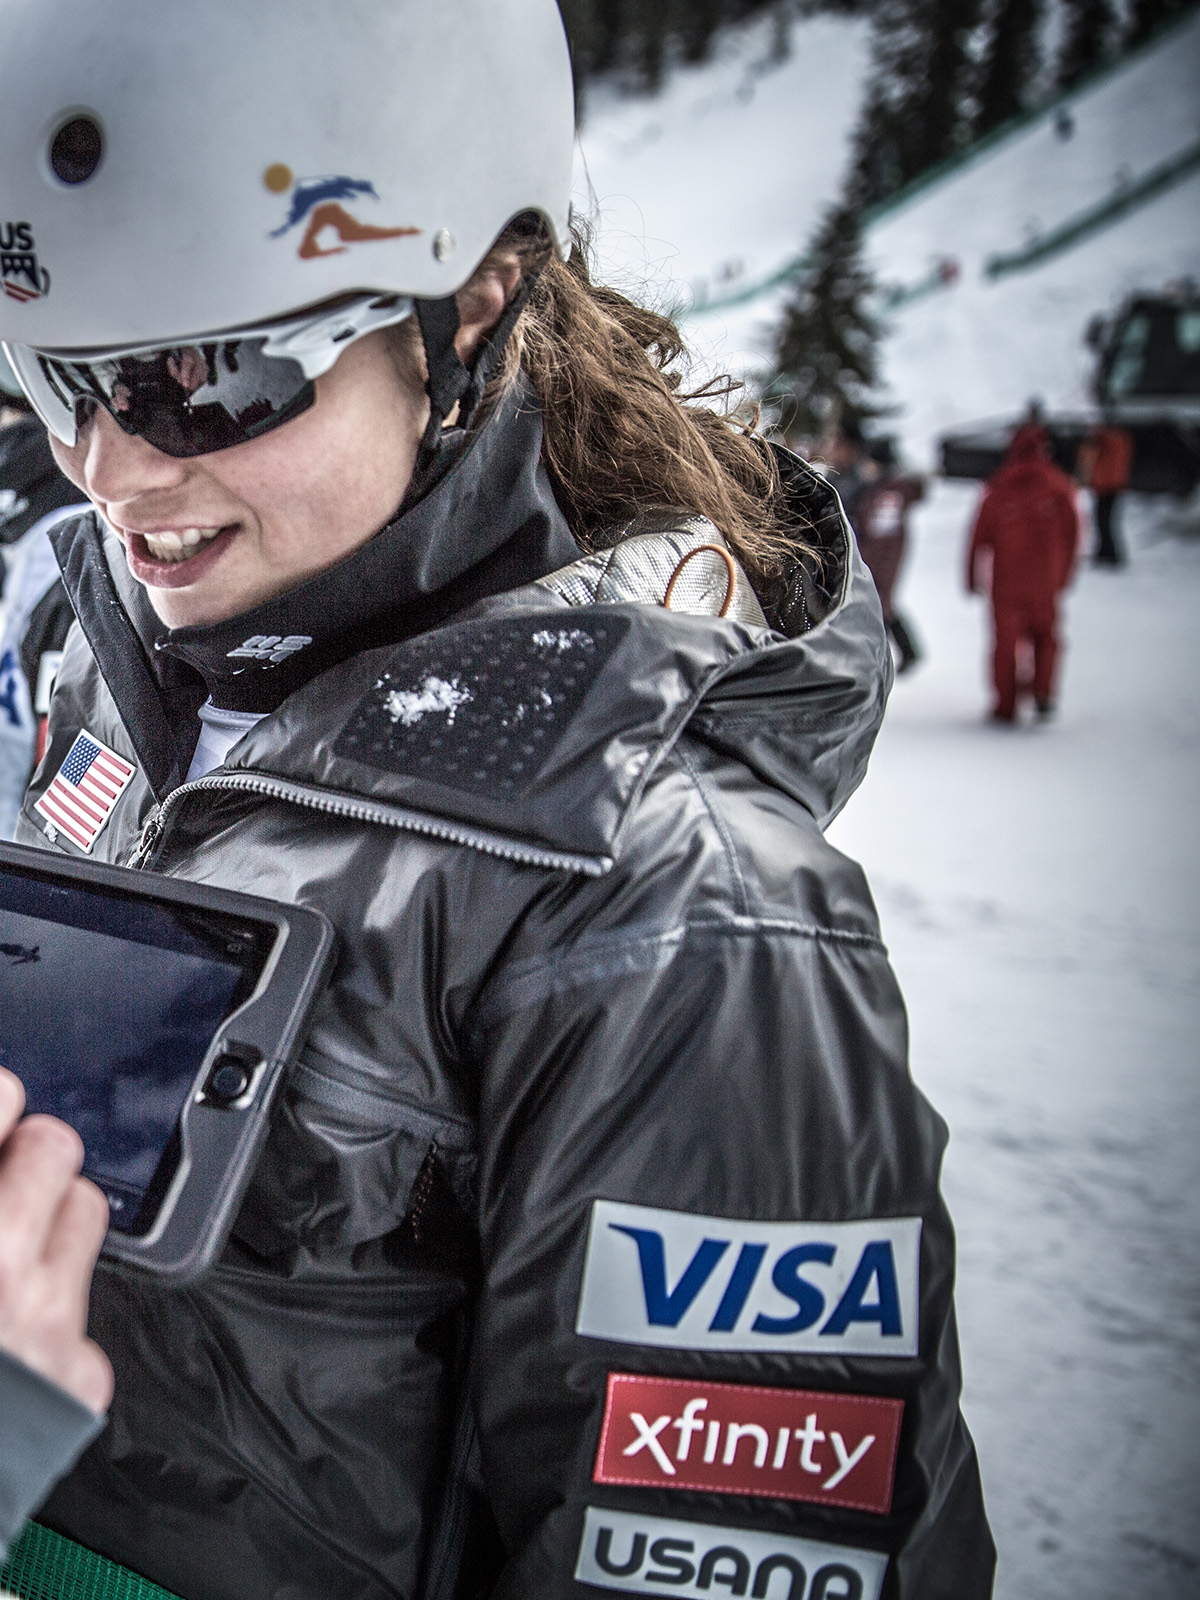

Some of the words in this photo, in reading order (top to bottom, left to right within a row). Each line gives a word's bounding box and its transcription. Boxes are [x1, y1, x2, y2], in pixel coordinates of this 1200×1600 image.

[607, 1222, 903, 1338] VISA
[623, 1398, 875, 1491] xfinity
[595, 1526, 864, 1600] USANA
